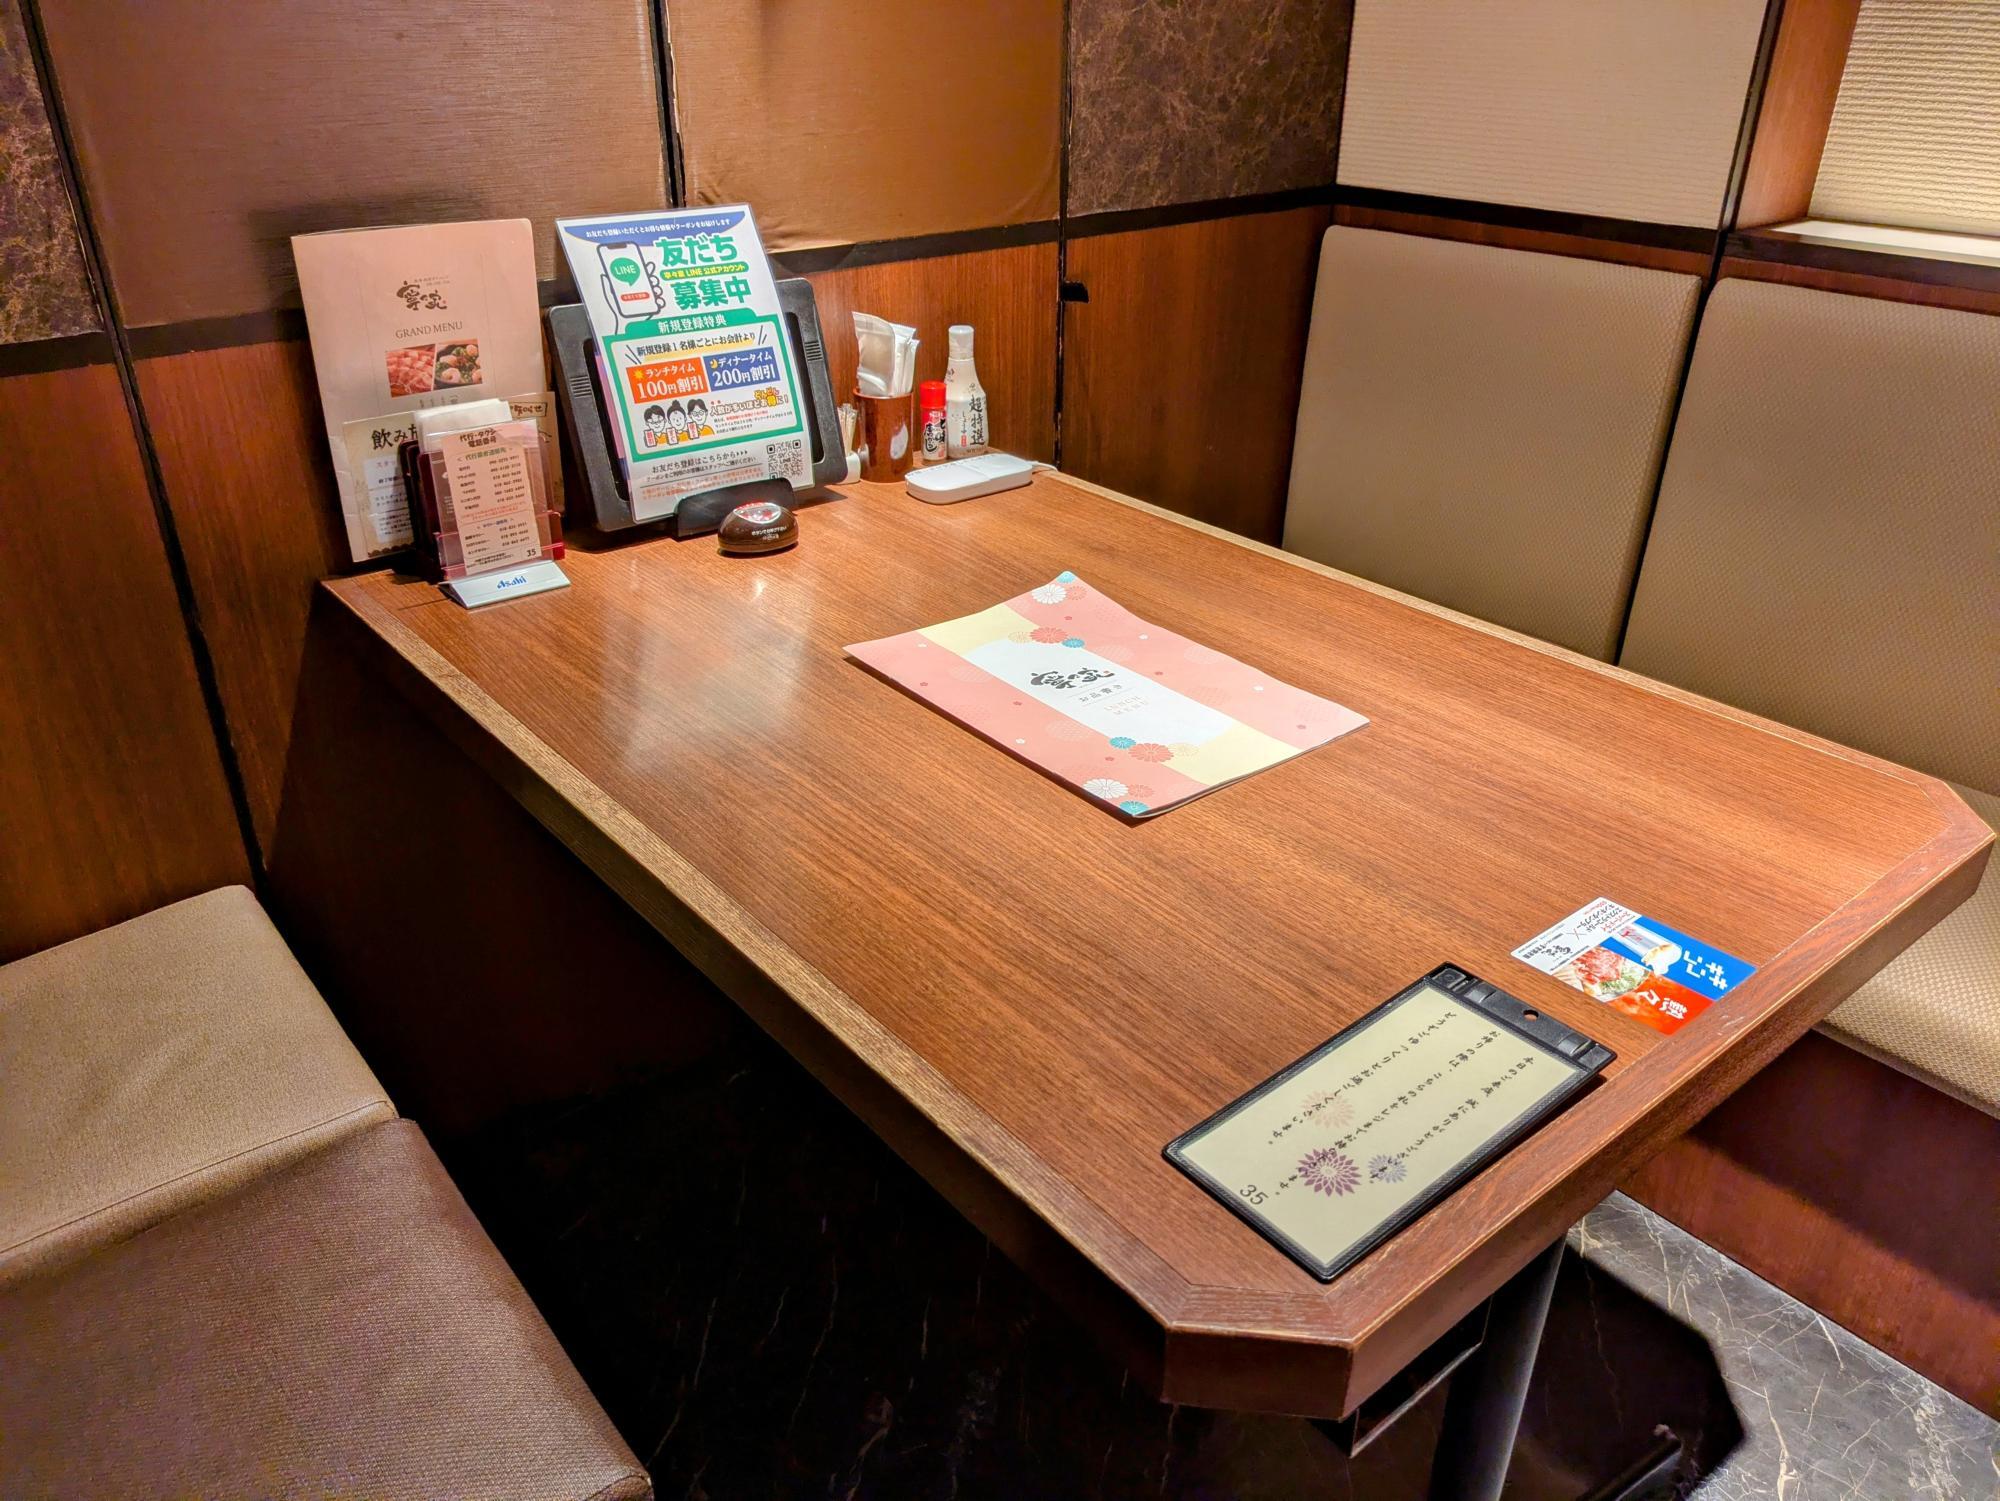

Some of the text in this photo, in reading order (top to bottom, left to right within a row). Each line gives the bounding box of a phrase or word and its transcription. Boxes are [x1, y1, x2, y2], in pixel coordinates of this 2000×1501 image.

[656, 234, 738, 267] 友だち
[615, 266, 636, 275] LINE
[686, 269, 703, 277] LINE
[704, 265, 745, 275] 公式アカウント
[670, 276, 752, 310] 募集中
[396, 321, 463, 339] GRAND MENU
[658, 314, 727, 334] 新規登録特典
[718, 353, 773, 368] ディナータイム
[646, 363, 695, 378] ランチタイム
[713, 364, 776, 387] 200円割引
[637, 375, 704, 399] 100円割引
[652, 451, 736, 474] お友だち登録はこちらから
[526, 549, 536, 557] 35
[497, 576, 527, 589] Asahi
[1238, 1183, 1270, 1206] 35
